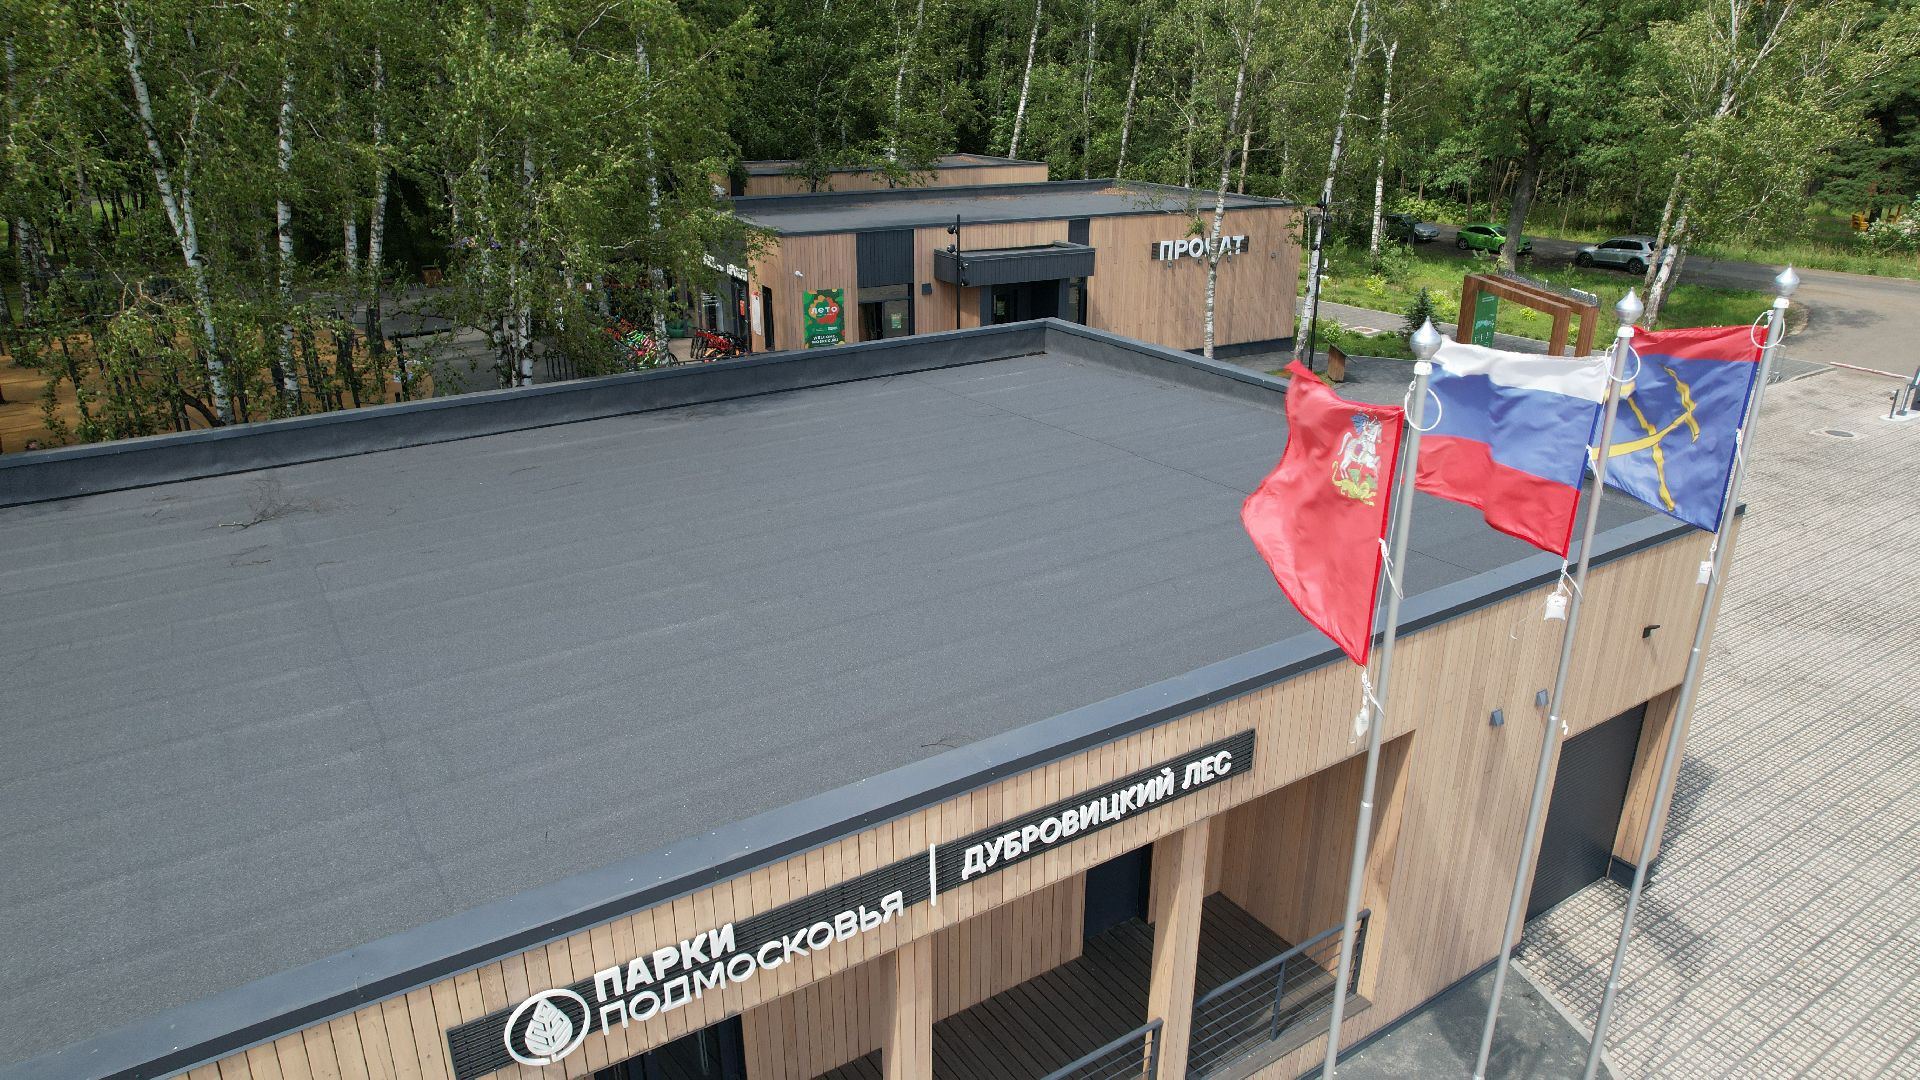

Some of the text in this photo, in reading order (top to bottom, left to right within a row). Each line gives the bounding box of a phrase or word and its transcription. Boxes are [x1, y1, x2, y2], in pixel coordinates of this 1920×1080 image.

[962, 750, 1233, 880] ДУБРОВИЦКИЙ ЛЕС
[593, 922, 737, 1002] ПАРКИ
[598, 889, 904, 1036] ПОДМОСКОВЬЯ
